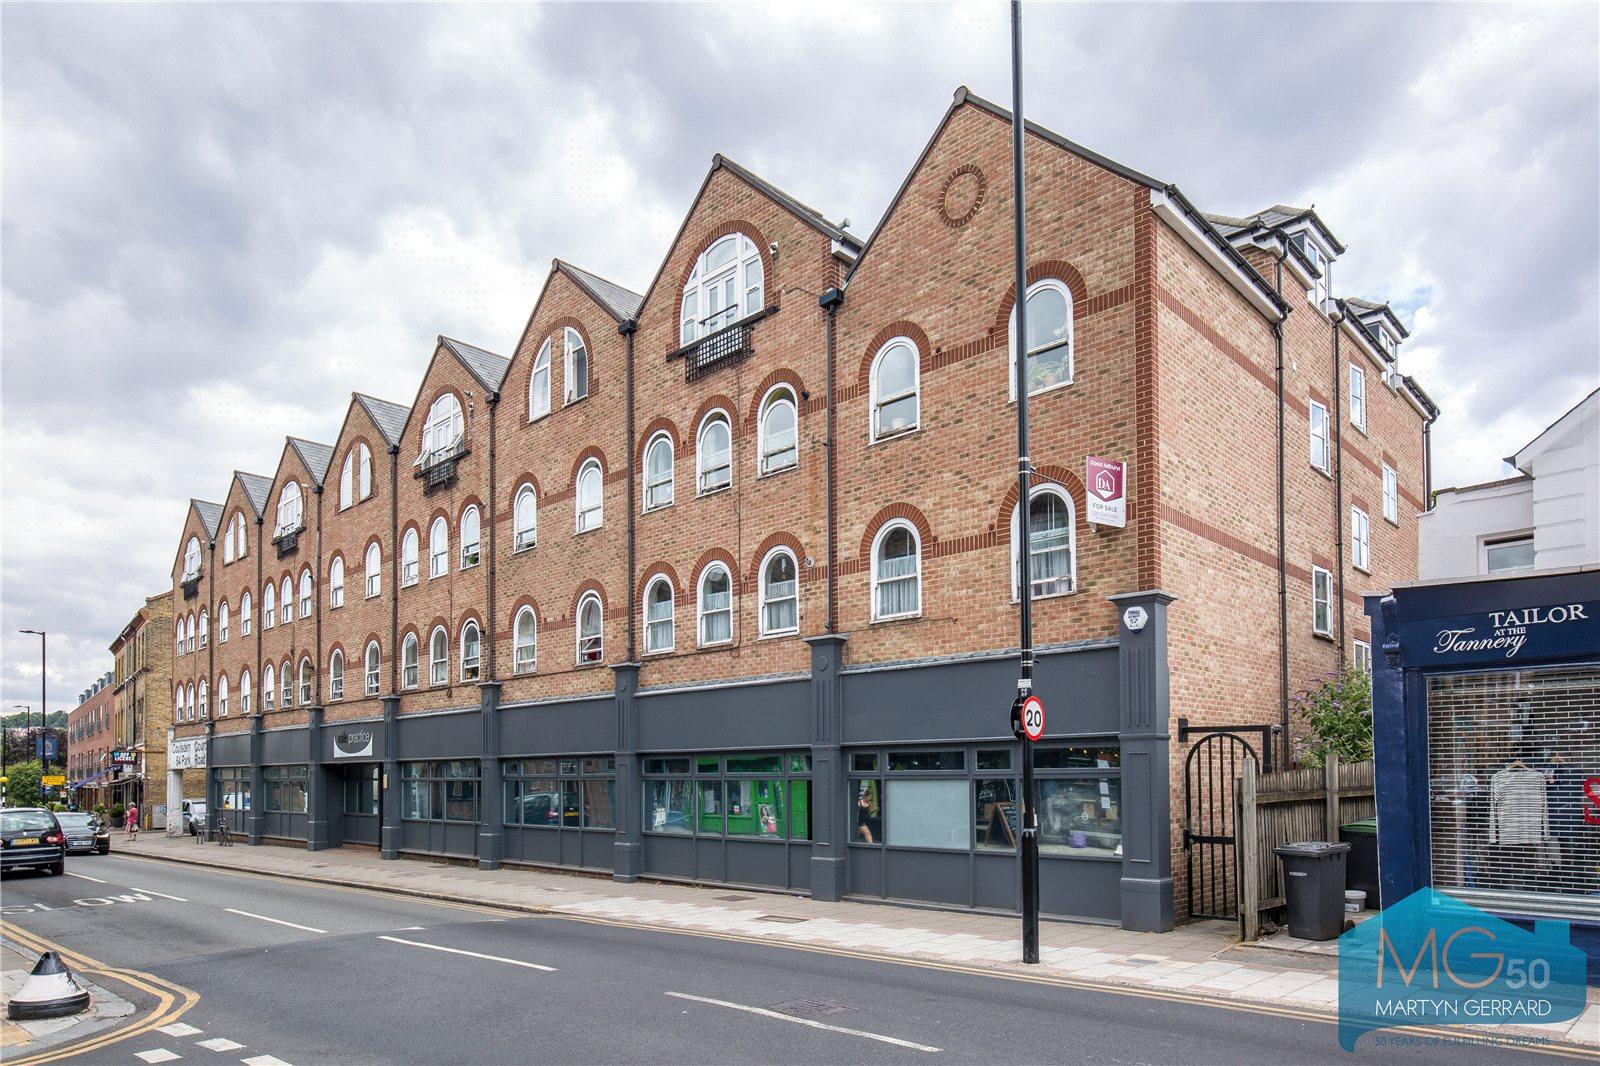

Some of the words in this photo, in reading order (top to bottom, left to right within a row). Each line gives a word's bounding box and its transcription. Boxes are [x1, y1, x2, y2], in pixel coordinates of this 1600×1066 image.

[1488, 604, 1588, 628] TAILOR
[1507, 627, 1526, 635] THE
[1433, 628, 1528, 657] Tannery
[1026, 709, 1042, 727] 20
[195, 753, 206, 766] Road
[0, 893, 153, 915] SLOW
